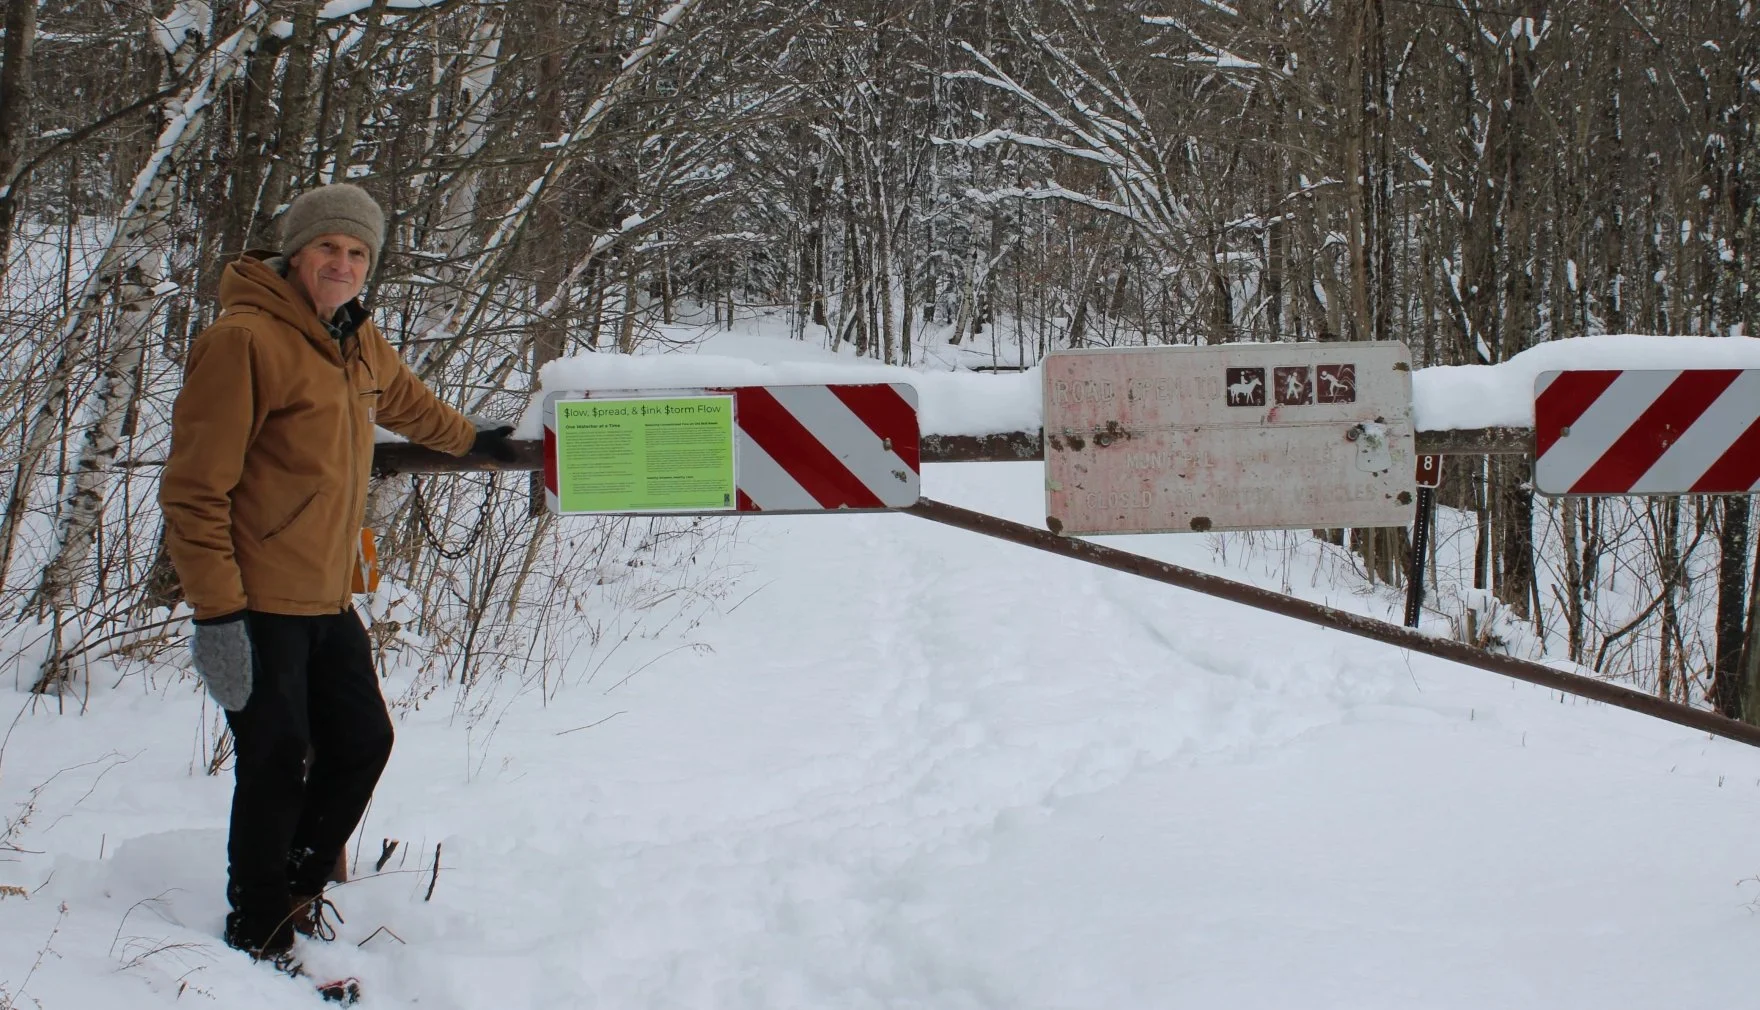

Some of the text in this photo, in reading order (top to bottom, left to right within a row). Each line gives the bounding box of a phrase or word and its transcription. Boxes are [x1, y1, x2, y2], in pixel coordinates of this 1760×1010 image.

[1055, 378, 1114, 403] ROAD
[563, 403, 721, 419] $low, $pread, & $ink $torm Flow
[1423, 455, 1433, 471] 8
